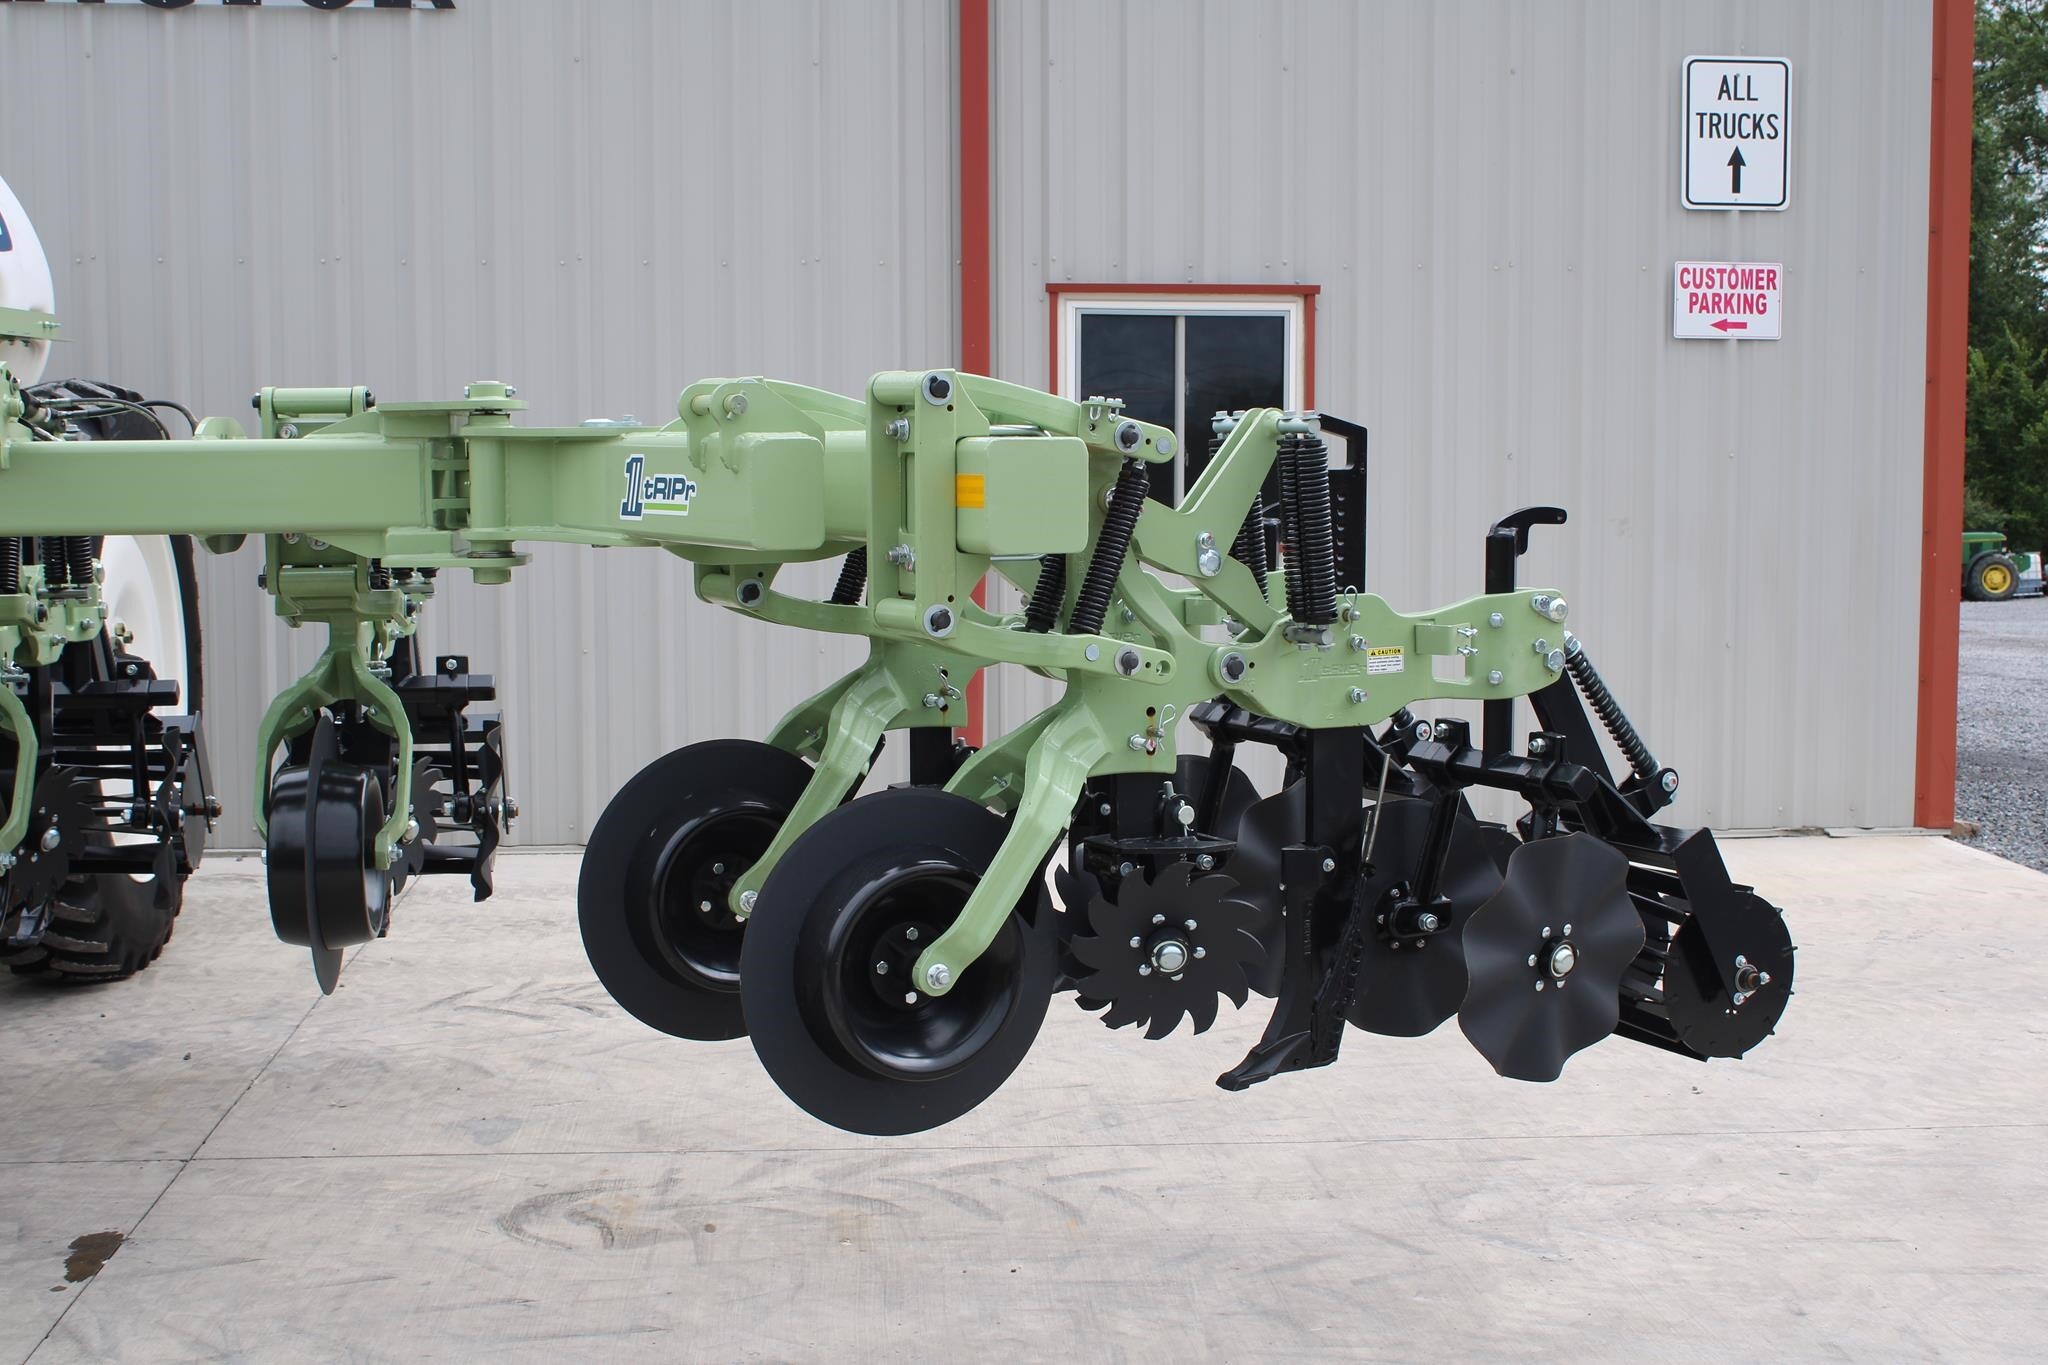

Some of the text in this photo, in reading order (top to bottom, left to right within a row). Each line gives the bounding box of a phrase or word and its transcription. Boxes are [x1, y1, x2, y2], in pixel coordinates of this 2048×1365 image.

[1717, 74, 1758, 101] ALL
[1696, 112, 1779, 140] TRUCKS
[1679, 267, 1777, 291] CUSTOMER
[1688, 292, 1767, 316] PARKING
[621, 457, 644, 516] 1
